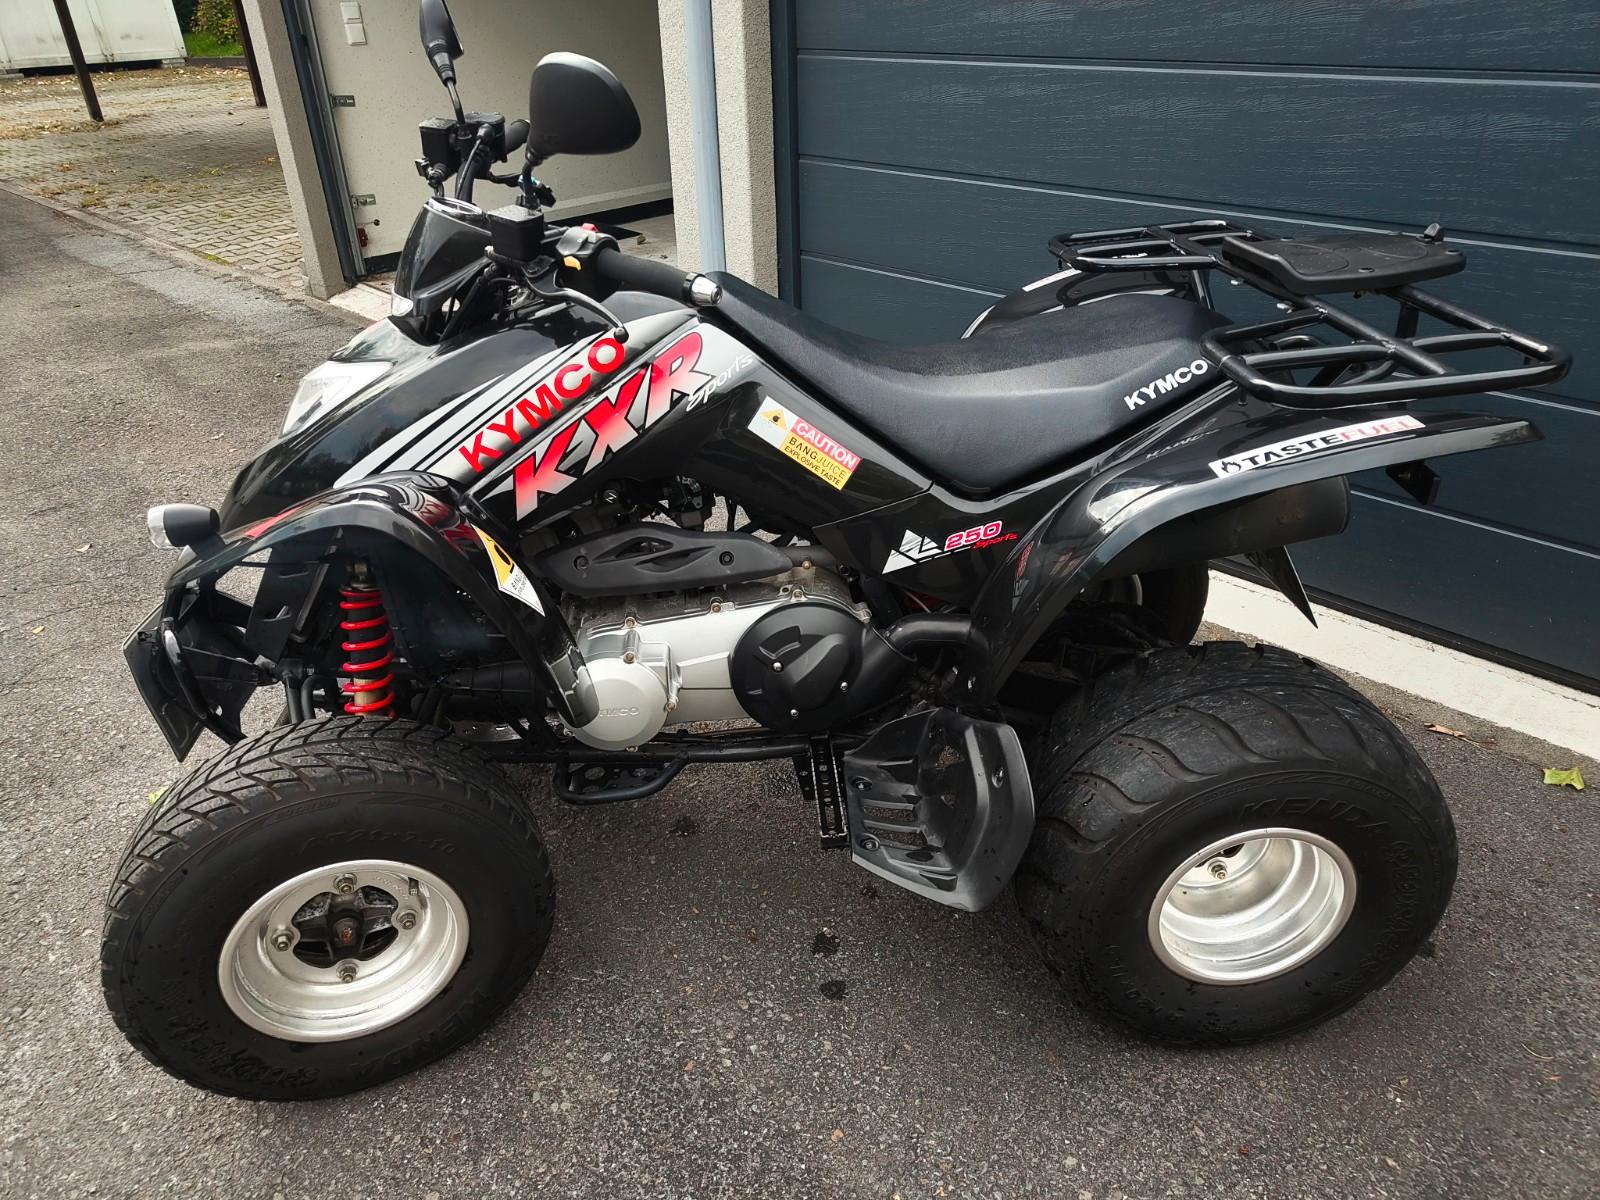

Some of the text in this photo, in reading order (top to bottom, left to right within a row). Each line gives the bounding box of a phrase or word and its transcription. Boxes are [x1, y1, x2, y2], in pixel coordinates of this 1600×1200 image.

[459, 337, 625, 473] KYMCO
[1124, 359, 1208, 411] KYMCO
[513, 331, 715, 521] KXR
[796, 423, 856, 469] CAUTION
[784, 445, 841, 486] EXPLOSIVE TASTE
[944, 520, 1003, 552] 250
[1241, 796, 1393, 833] KENDA
